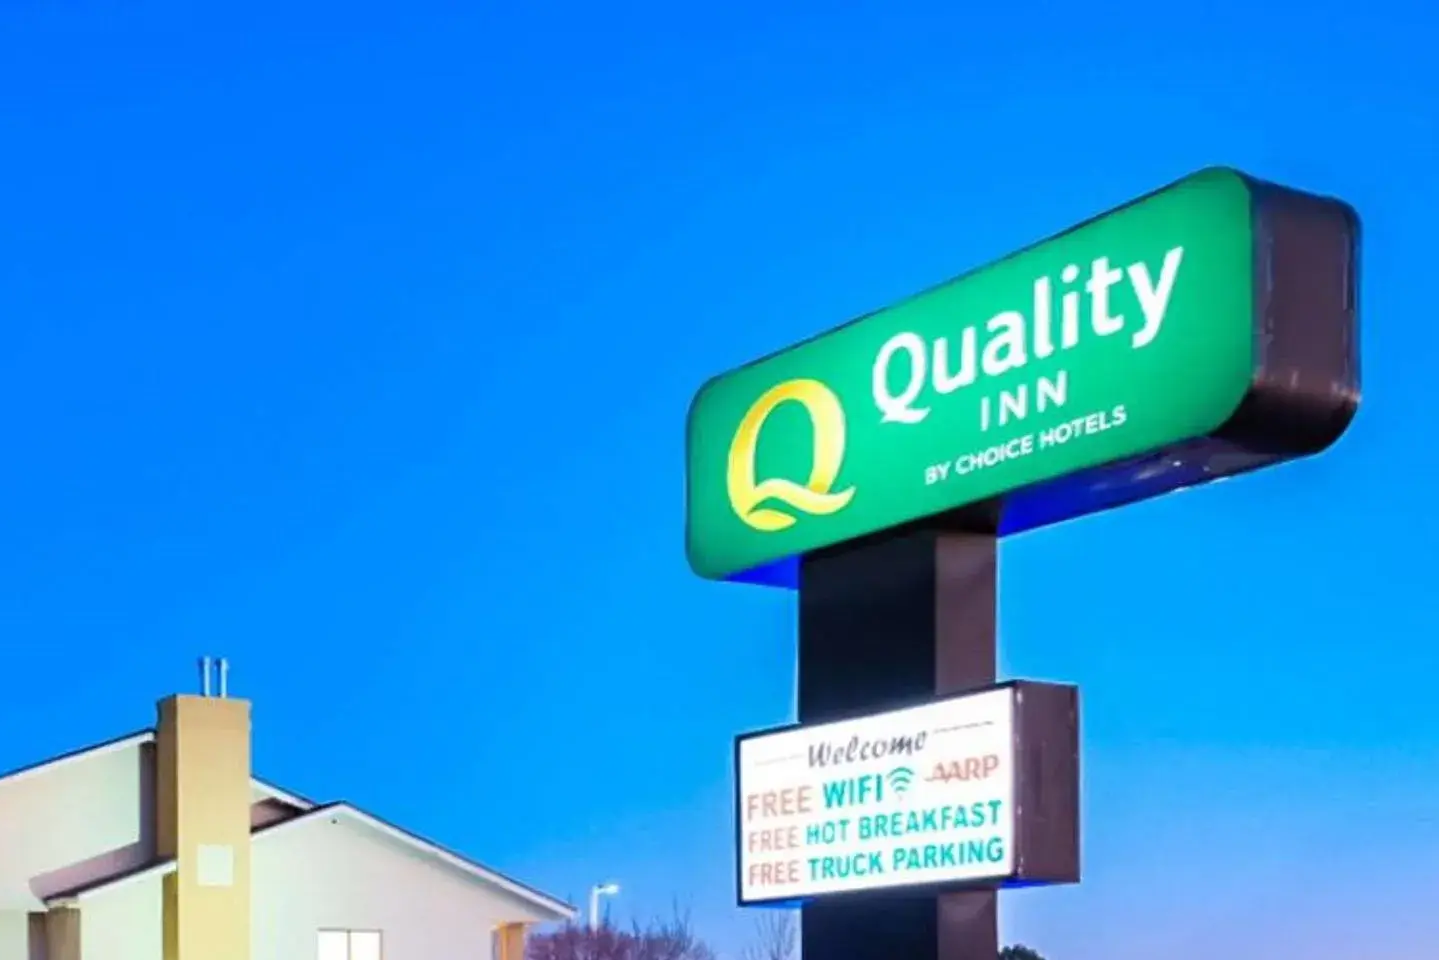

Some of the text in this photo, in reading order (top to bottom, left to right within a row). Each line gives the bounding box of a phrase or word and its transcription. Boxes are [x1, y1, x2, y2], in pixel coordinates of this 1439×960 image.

[871, 246, 1184, 424] Quality
[980, 370, 1067, 431] INN
[726, 378, 856, 531] Q
[924, 406, 1127, 485] BY CHOICE HOTELS
[808, 730, 927, 768] Welcome
[925, 754, 1000, 784] AARP
[747, 774, 884, 821] FREE WIFI
[748, 799, 1002, 853] FREE HOT BREAKFAST
[748, 837, 1005, 887] FREE TRUCK PARKING
